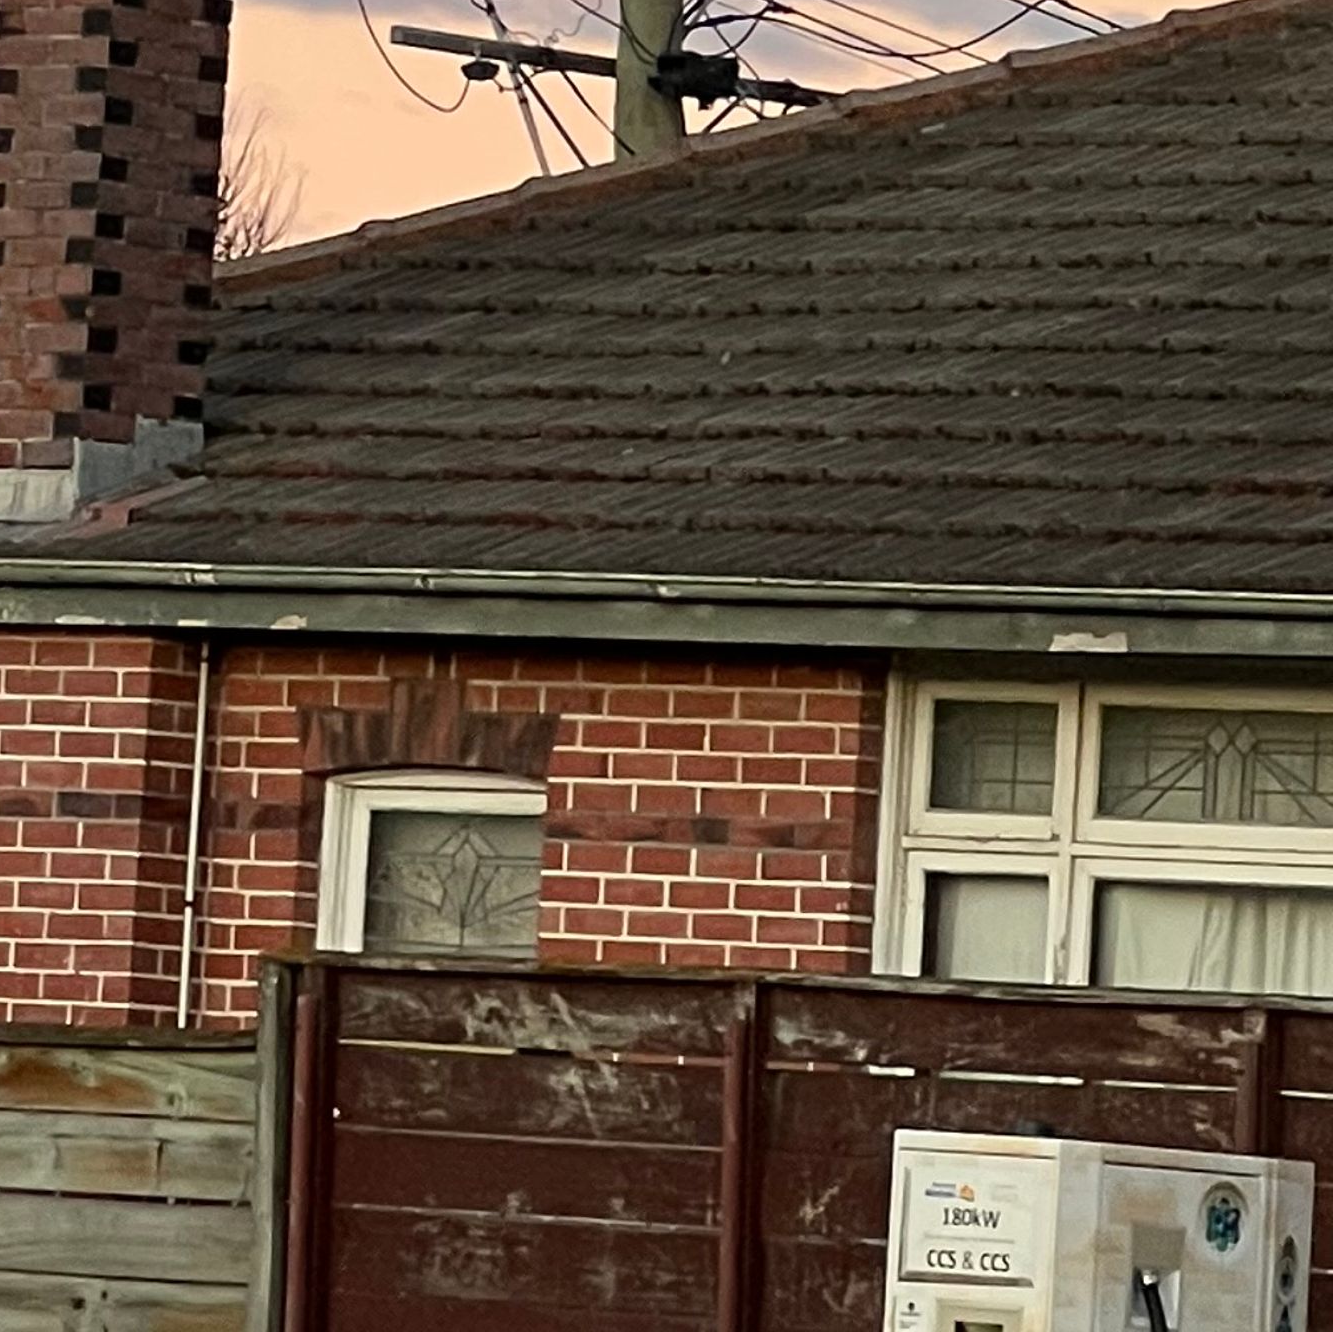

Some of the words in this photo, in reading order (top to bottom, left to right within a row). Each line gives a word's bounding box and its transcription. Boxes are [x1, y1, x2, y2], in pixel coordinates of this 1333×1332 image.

[942, 1207, 1002, 1229] 180kW
[926, 1248, 957, 1269] CCS
[962, 1251, 974, 1270] &
[980, 1252, 1011, 1273] CCS
